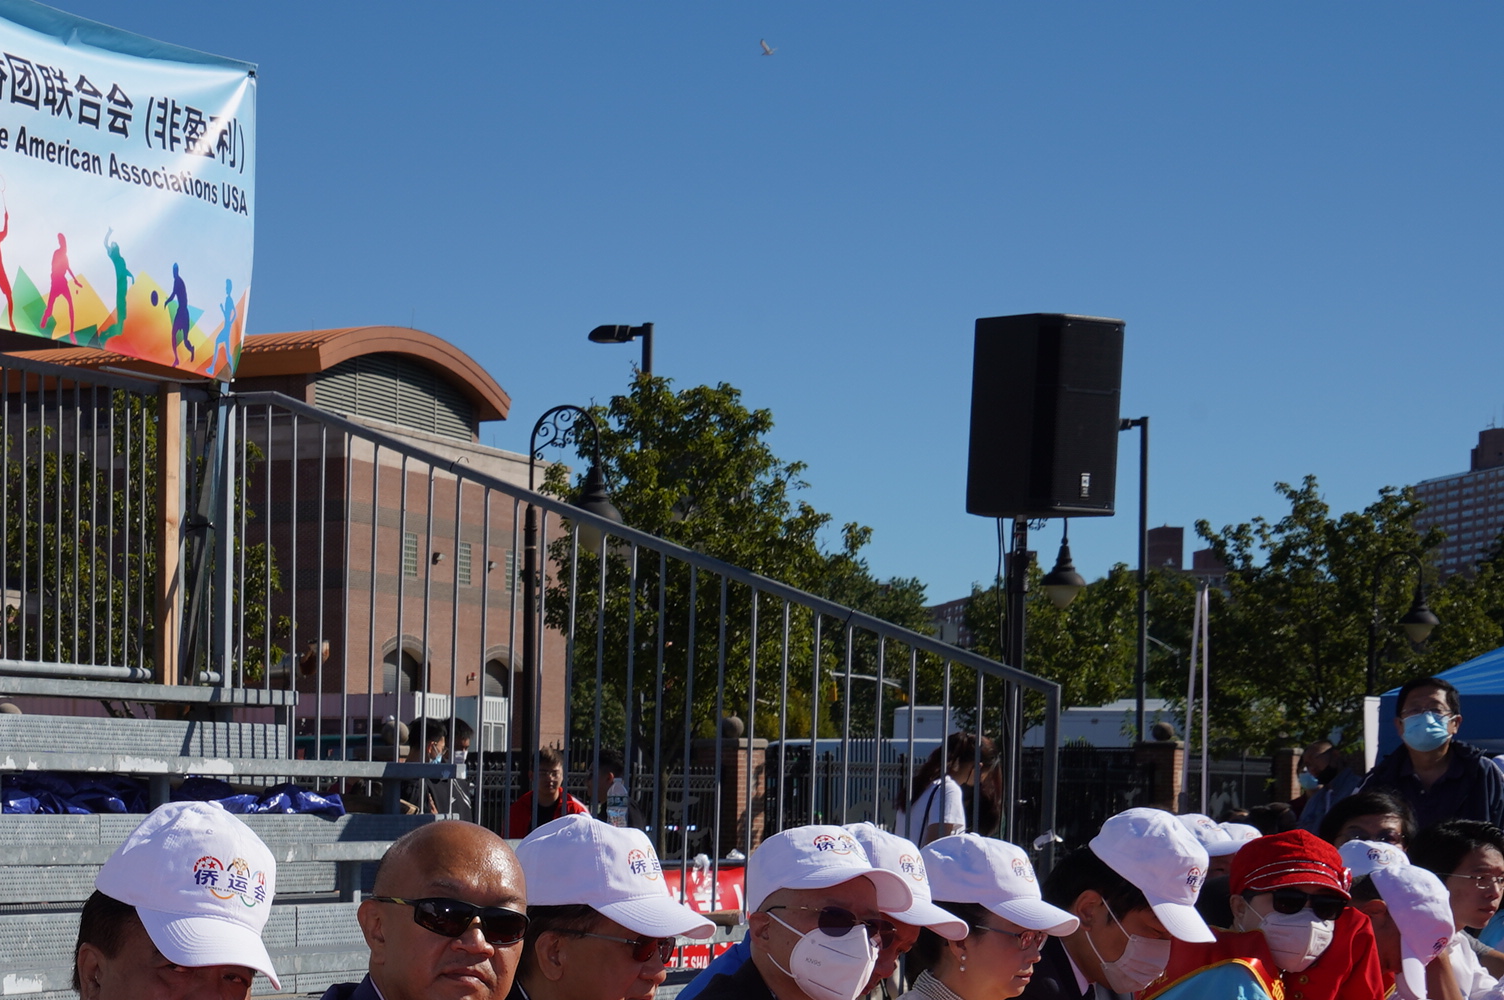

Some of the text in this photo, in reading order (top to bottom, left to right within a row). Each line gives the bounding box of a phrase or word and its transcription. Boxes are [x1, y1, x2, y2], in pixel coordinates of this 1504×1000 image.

[15, 126, 103, 176] American
[109, 152, 219, 206] Associations
[222, 183, 248, 216] USA
[194, 869, 267, 904] 侨运会
